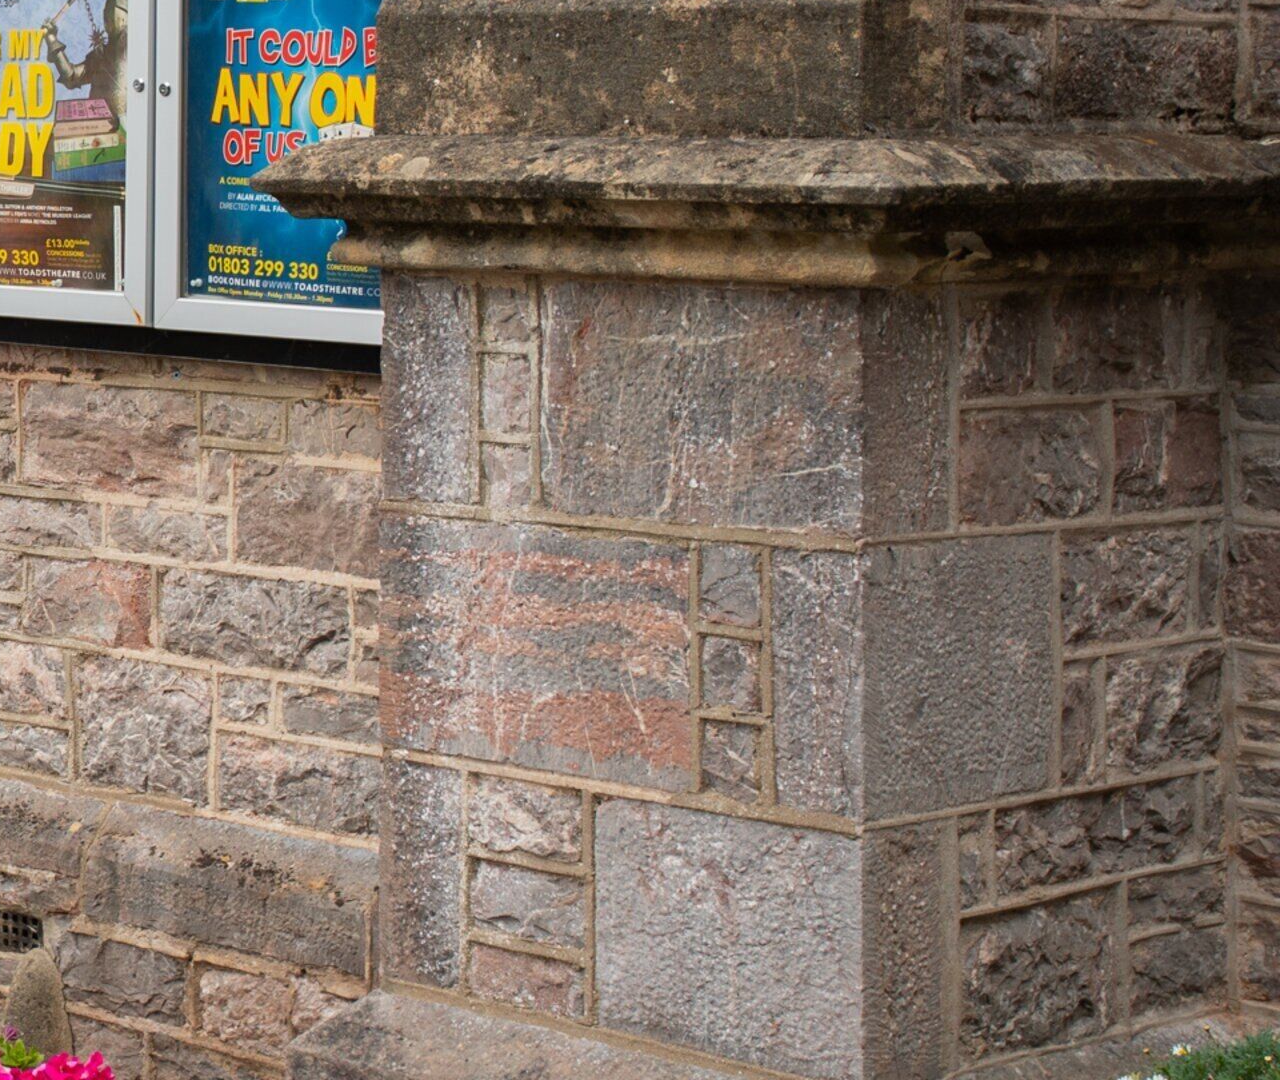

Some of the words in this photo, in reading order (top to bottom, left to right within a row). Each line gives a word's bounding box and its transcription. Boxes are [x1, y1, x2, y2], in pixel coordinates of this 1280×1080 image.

[8, 28, 46, 60] MY
[225, 27, 254, 65] IT
[258, 26, 357, 66] COULD
[362, 27, 377, 67] B
[211, 67, 306, 127] ANY
[309, 71, 377, 129] ON
[222, 128, 261, 165] OF
[265, 130, 308, 164] US
[220, 177, 225, 185] A
[227, 177, 250, 186] COME
[236, 193, 254, 201] ALAN
[220, 202, 250, 211] DIRECTED
[258, 205, 271, 213] JILL
[46, 239, 75, 249] £13.00
[208, 243, 225, 254] BOX
[226, 244, 257, 256] OFFICE
[12, 250, 39, 266] 330
[208, 256, 250, 276] 01803
[255, 258, 284, 278] 299
[288, 262, 319, 280] 330
[243, 289, 263, 298] Monday
